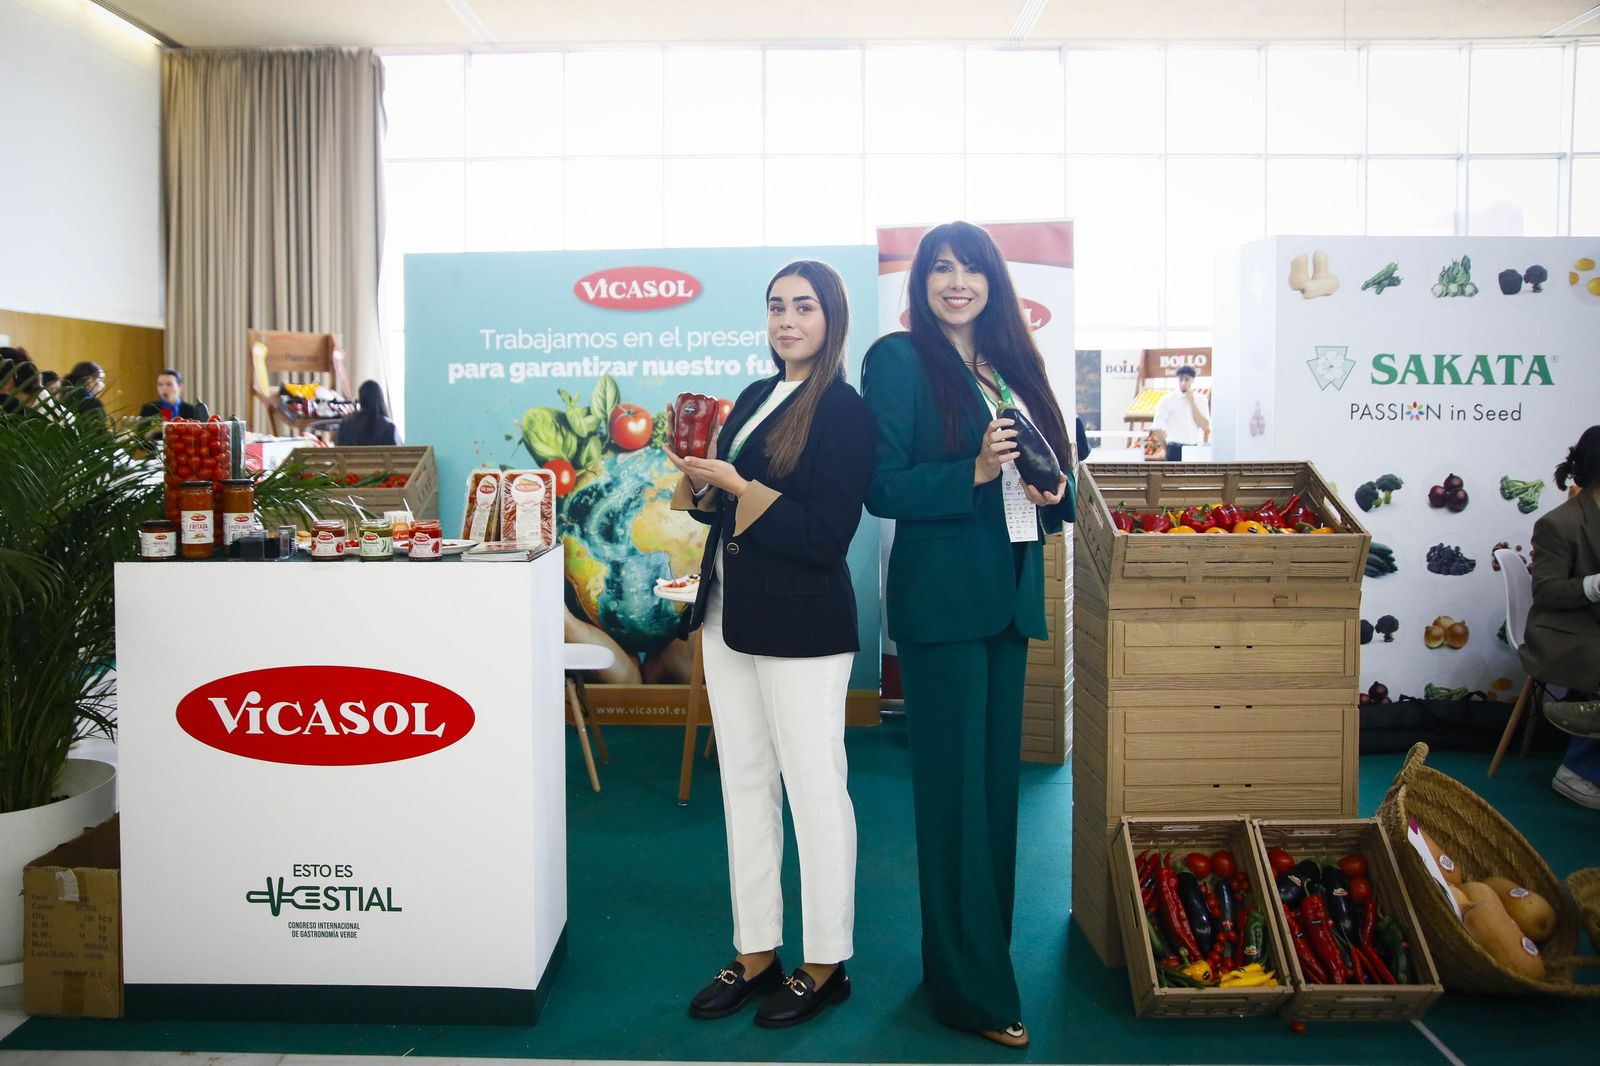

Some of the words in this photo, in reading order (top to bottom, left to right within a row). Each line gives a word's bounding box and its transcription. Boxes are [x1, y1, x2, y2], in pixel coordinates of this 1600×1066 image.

[480, 329, 617, 353] Trabajamos
[623, 331, 652, 348] en
[660, 326, 681, 347] el
[449, 361, 505, 384] para
[510, 356, 638, 382] garantizar
[643, 356, 741, 378] nuestro
[1370, 353, 1556, 386] SAKATA
[1450, 403, 1466, 421] in
[1473, 402, 1522, 422] Seed
[596, 705, 687, 715] www.vicasol.es
[293, 864, 332, 878] ESTO
[335, 864, 354, 878] ES
[288, 921, 317, 929] CONGRESO
[317, 922, 361, 930] INTERNACIONAL
[291, 930, 299, 938] DE
[300, 929, 339, 938] GASTRONOMÍA
[339, 931, 358, 939] VERDE
